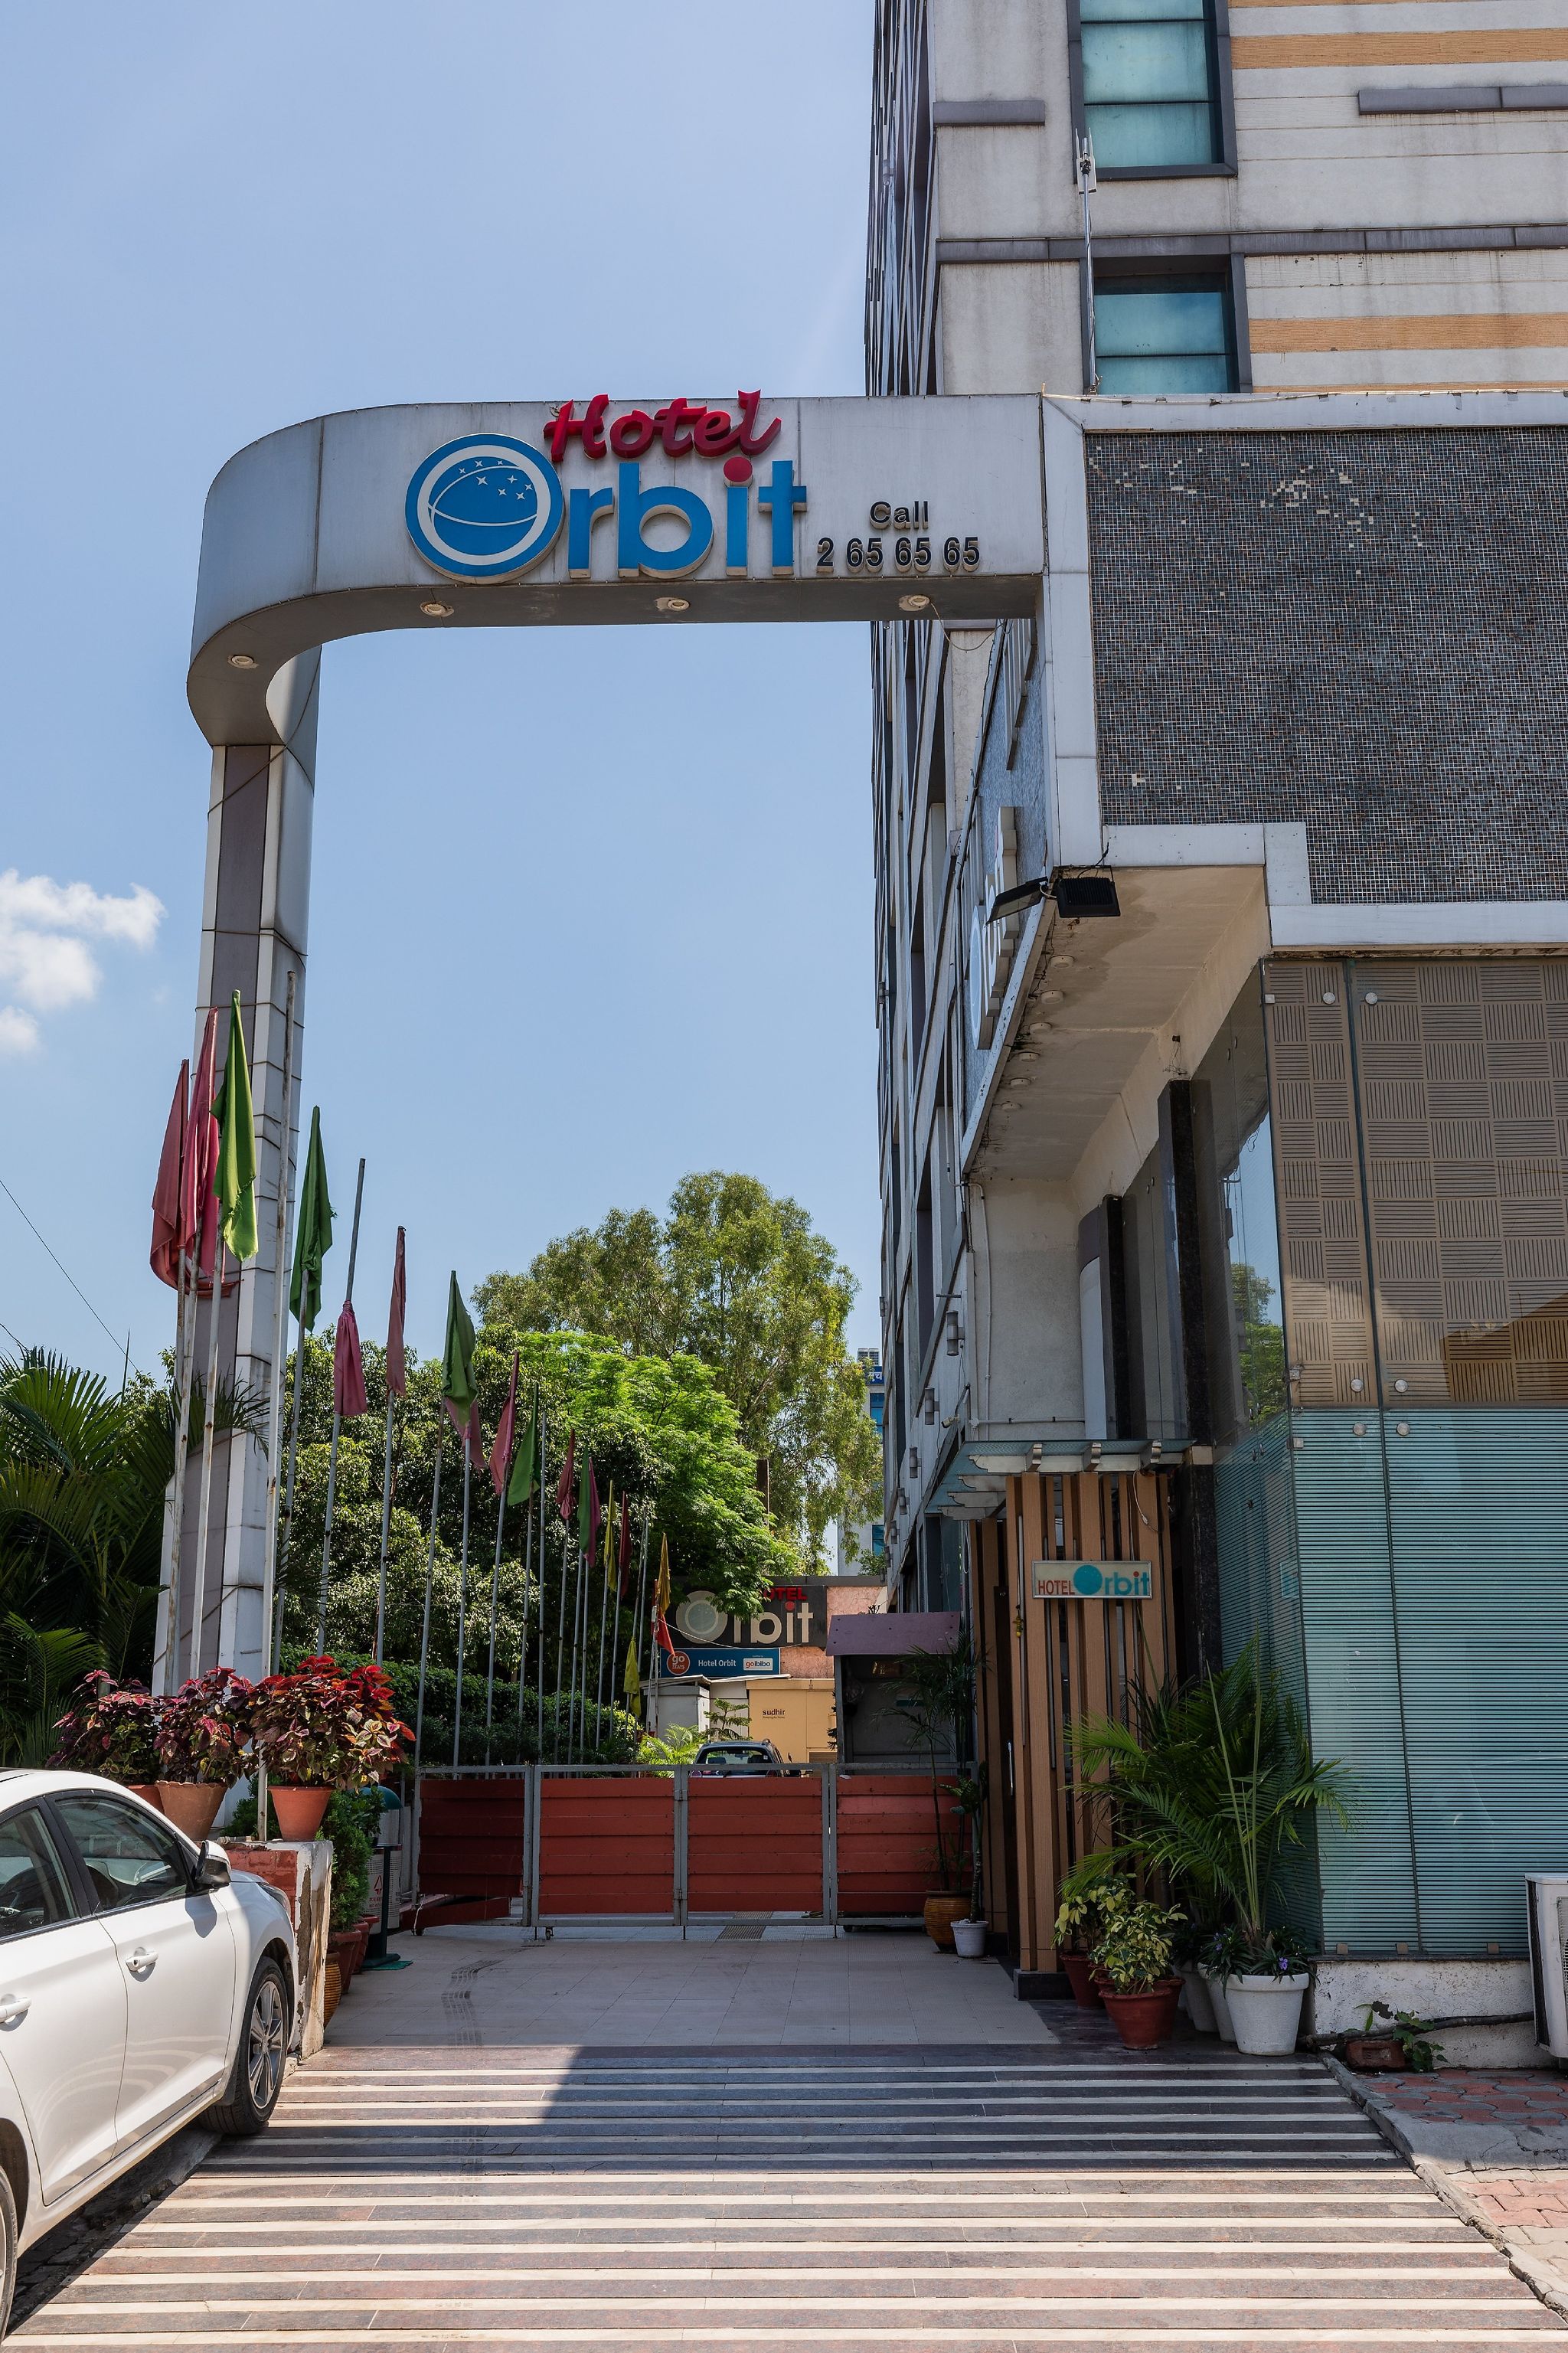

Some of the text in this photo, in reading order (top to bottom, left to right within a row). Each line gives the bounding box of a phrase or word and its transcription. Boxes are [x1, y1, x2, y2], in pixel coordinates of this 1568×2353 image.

[543, 389, 782, 461] Hotel
[405, 433, 808, 584] Orbit
[870, 500, 929, 530] Call
[817, 536, 981, 573] 2 65 65 65
[762, 1587, 808, 1601] OTEL
[1037, 1564, 1149, 1596] HOTEL Orbit
[671, 1655, 685, 1665] go
